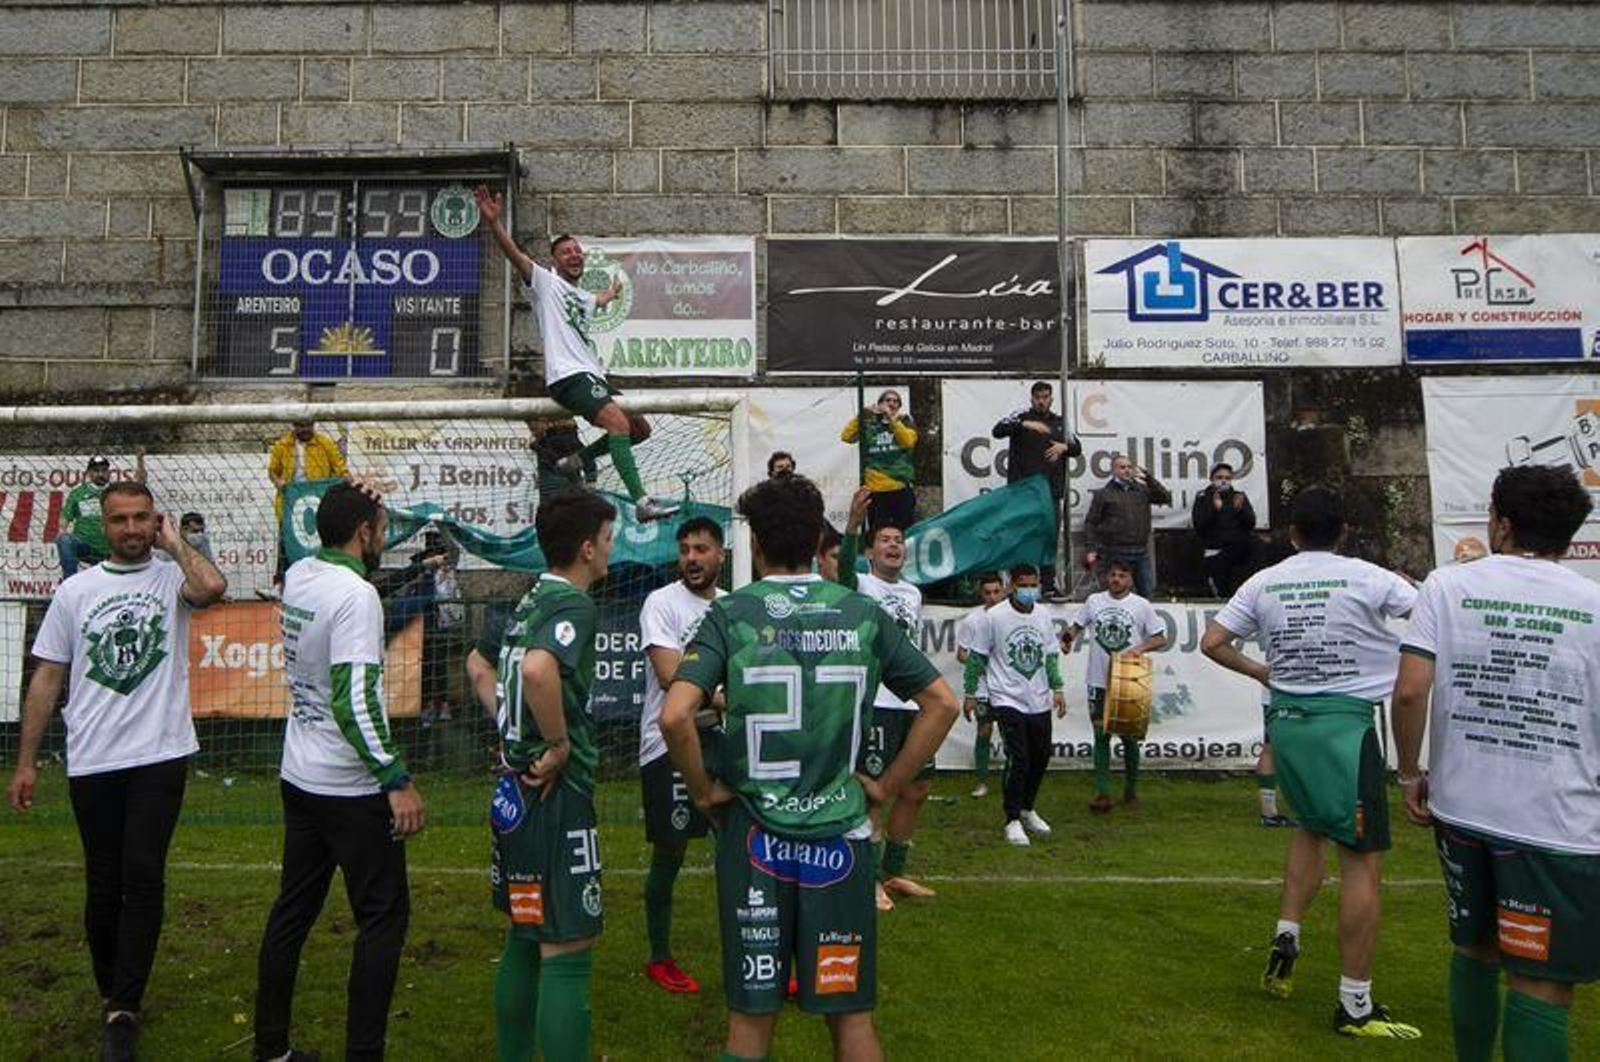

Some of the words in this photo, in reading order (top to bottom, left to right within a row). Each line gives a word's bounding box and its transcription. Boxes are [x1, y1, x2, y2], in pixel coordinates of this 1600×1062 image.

[261, 249, 441, 285] OCASO
[1217, 281, 1385, 309] CER&BER
[236, 297, 301, 315] ARENTEIRO
[394, 297, 462, 315] VISITANTE
[874, 317, 1057, 330] restaurante-bar
[1404, 312, 1455, 323] HOGAR
[1458, 311, 1467, 322] Y
[429, 327, 462, 376] 0
[1103, 337, 1134, 349] Julio
[1243, 337, 1259, 348] 10
[608, 337, 751, 368] ARENTEIRO
[366, 436, 418, 450] TALLER
[439, 463, 523, 487] Benito
[1484, 614, 1509, 628] UN
[743, 665, 868, 780] 27
